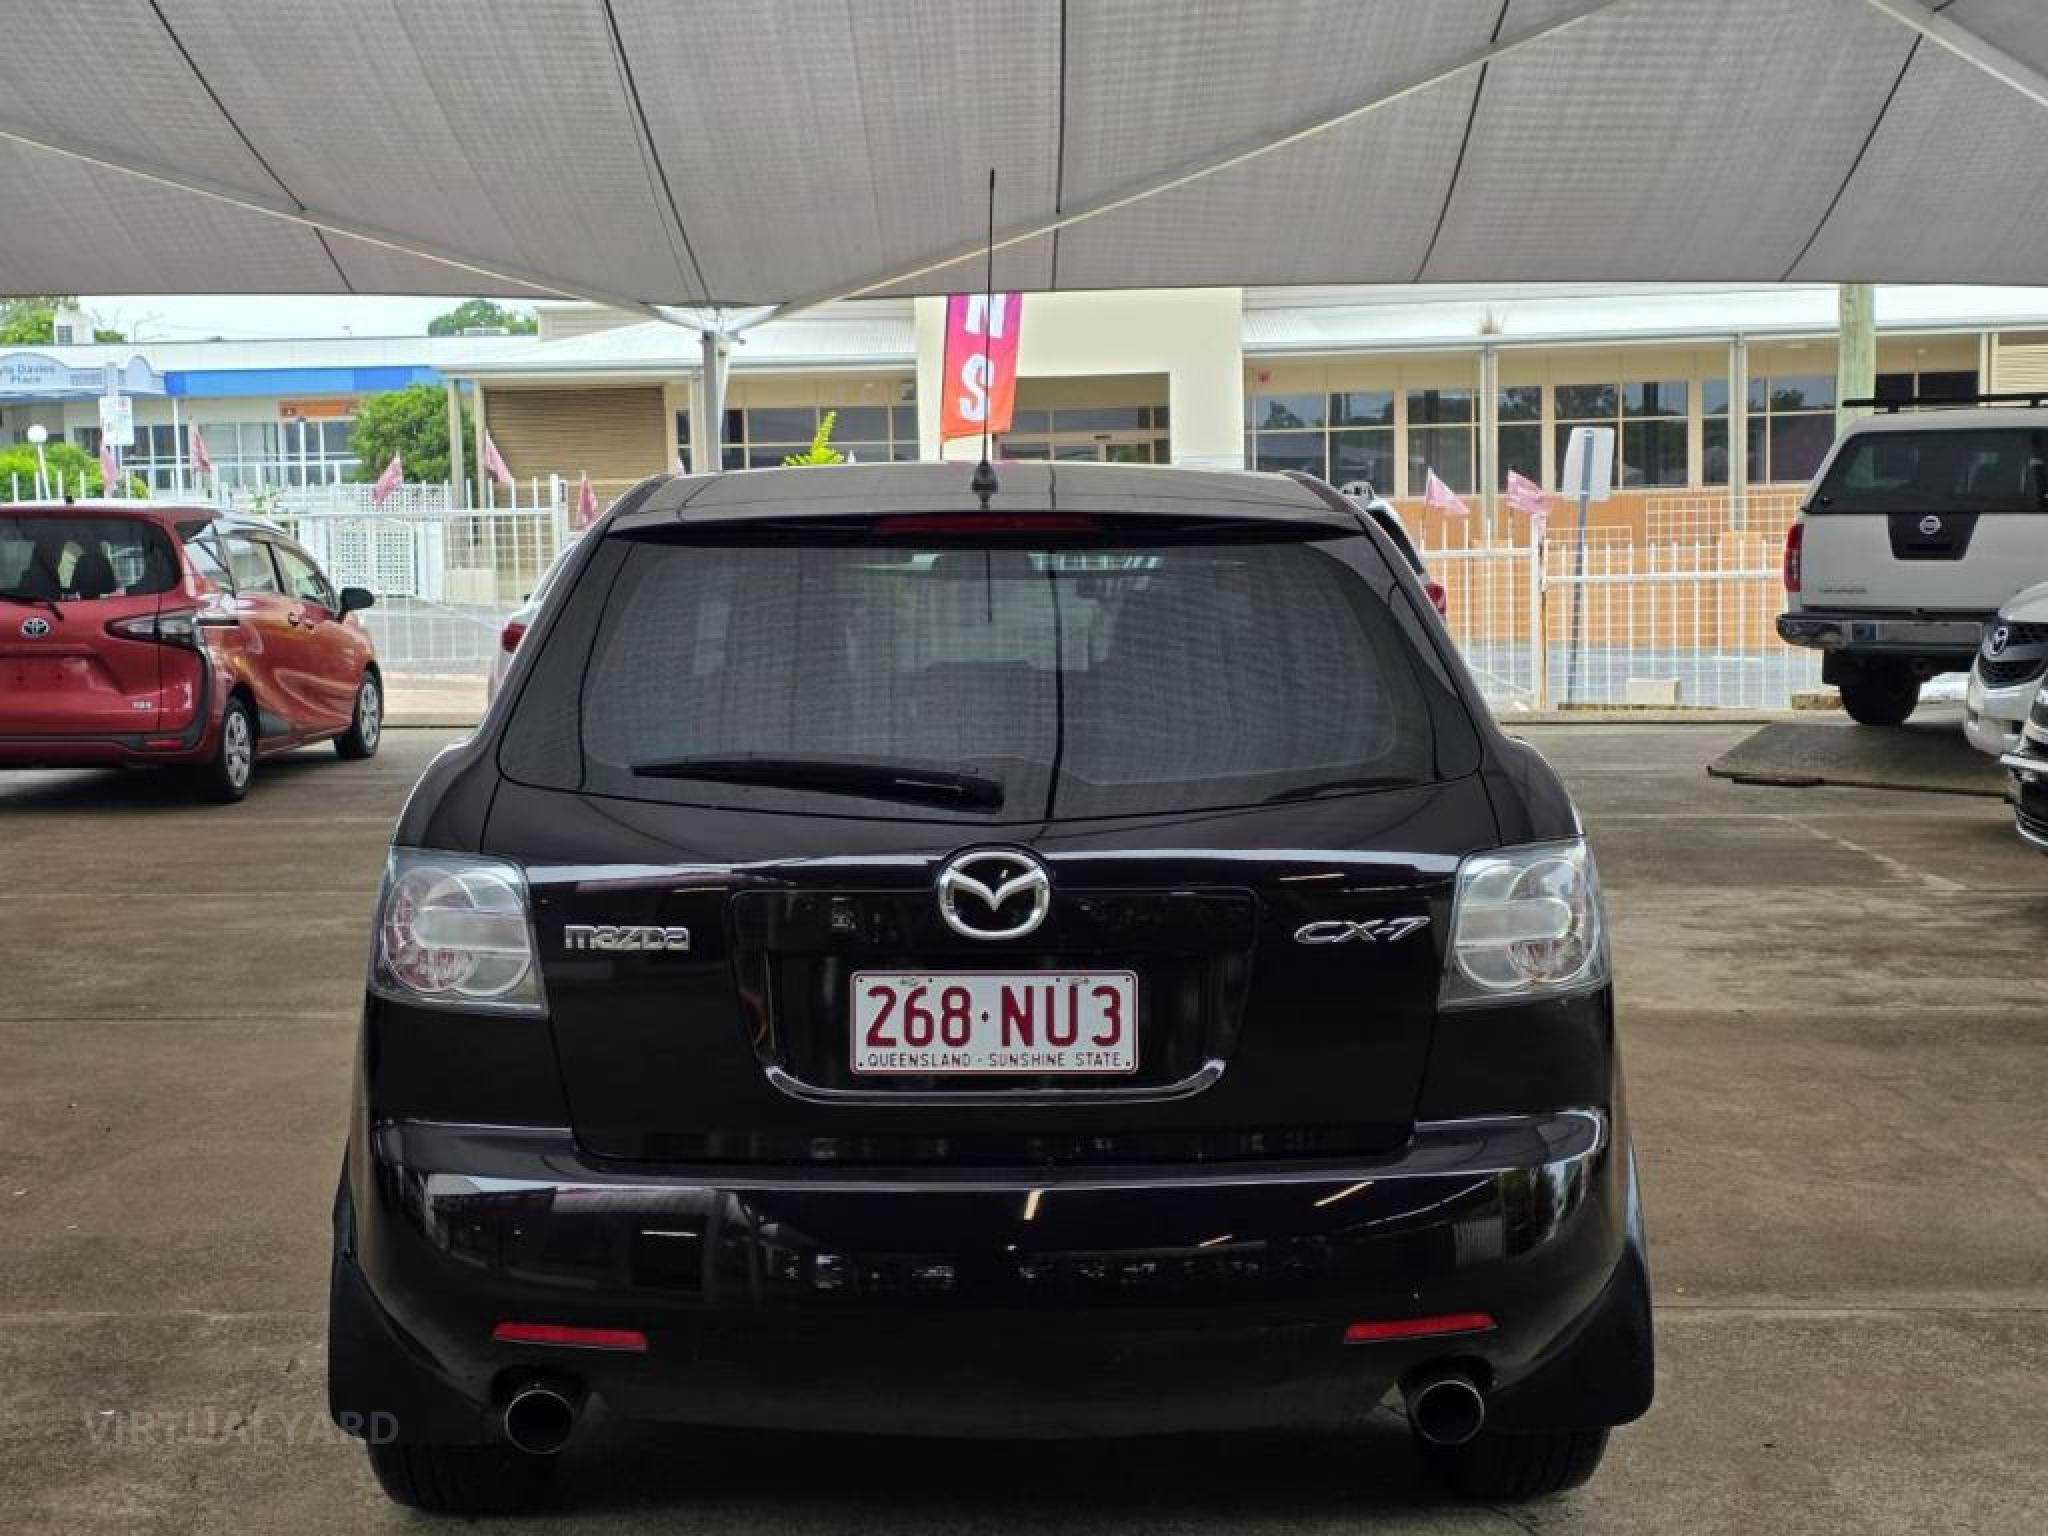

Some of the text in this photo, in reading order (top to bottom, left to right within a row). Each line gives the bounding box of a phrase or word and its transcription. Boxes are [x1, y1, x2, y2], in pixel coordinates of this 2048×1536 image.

[1294, 915, 1431, 944] CX-7
[867, 1052, 971, 1067] QUEENSLAND
[988, 1052, 1066, 1067] SUNSHINE
[1075, 1052, 1122, 1067] STATE
